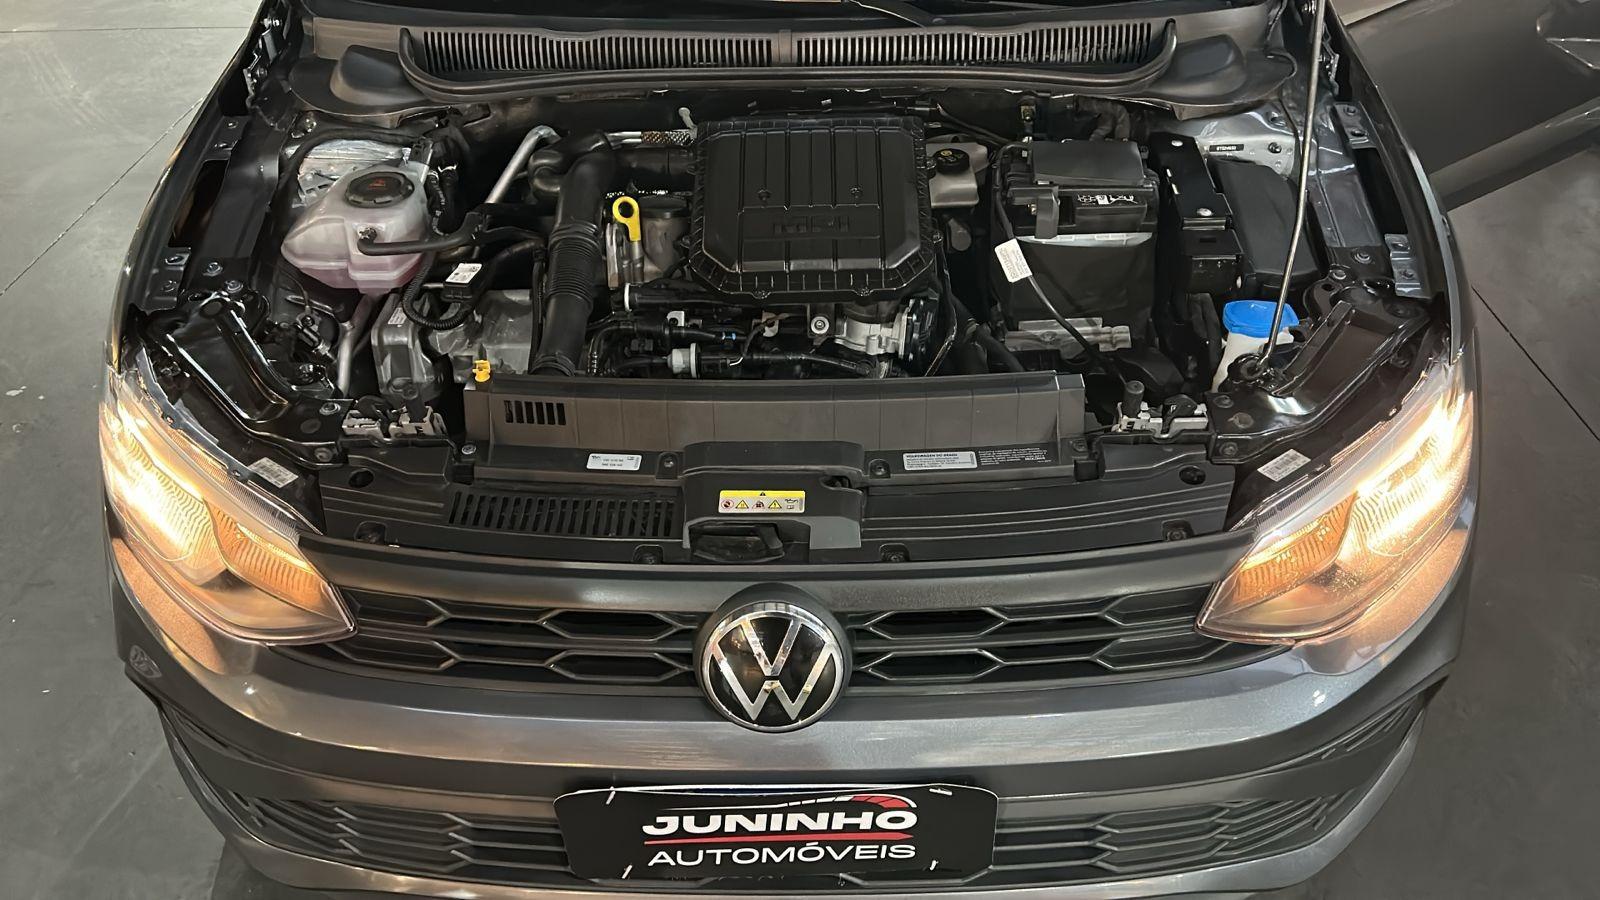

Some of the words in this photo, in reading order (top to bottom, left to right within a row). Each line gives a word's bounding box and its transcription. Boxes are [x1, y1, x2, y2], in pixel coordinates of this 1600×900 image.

[709, 616, 833, 721] VW
[642, 810, 918, 836] JUNINHO
[647, 842, 917, 866] AUTOMÓVEIS
